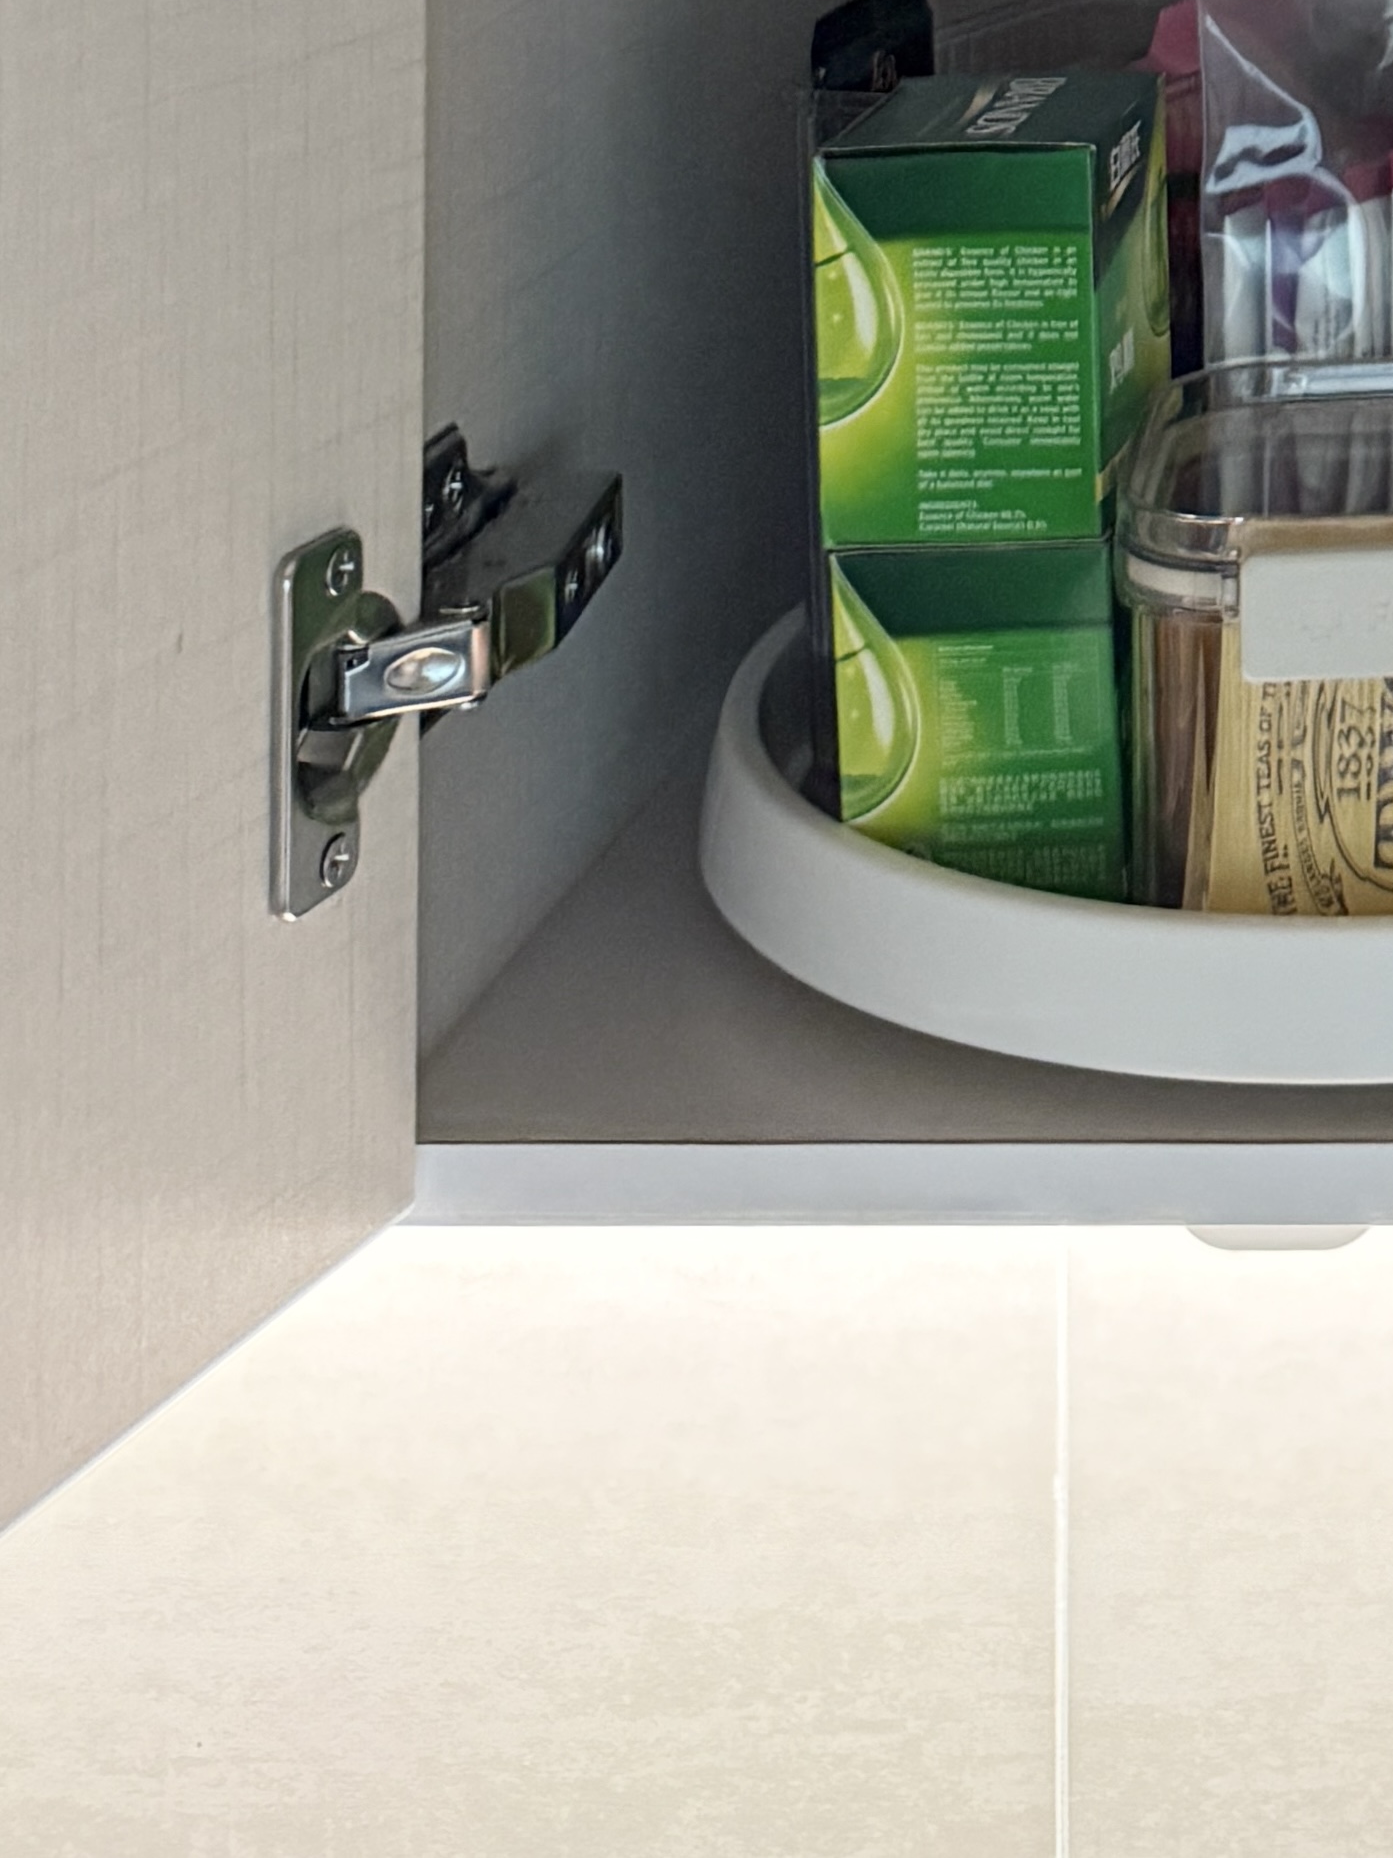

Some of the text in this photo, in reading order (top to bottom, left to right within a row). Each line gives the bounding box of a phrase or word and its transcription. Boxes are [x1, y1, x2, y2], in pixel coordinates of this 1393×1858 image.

[1256, 706, 1291, 917] THE FINEST TEAS OF
[1336, 696, 1362, 801] 1837
